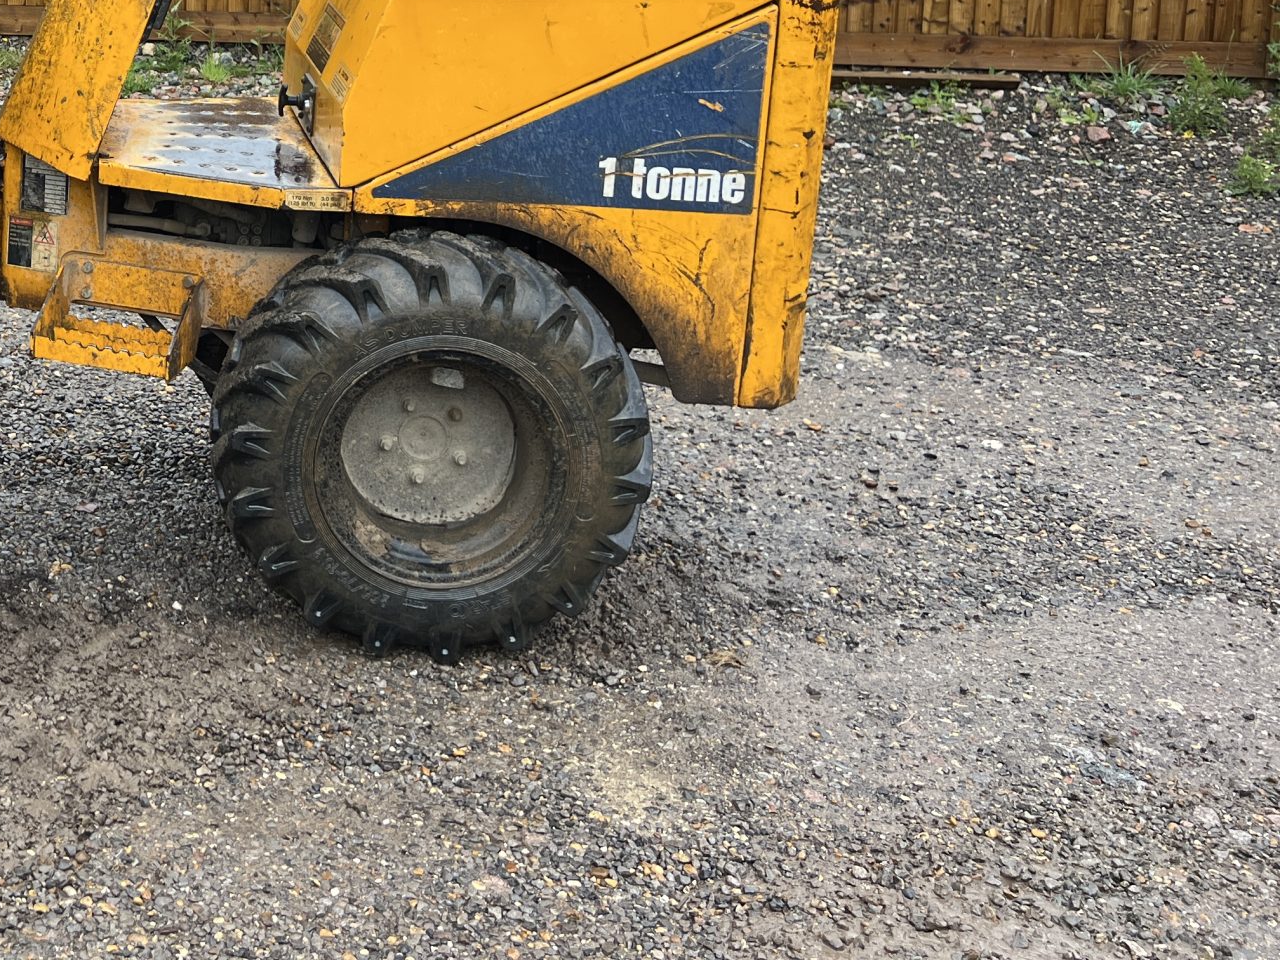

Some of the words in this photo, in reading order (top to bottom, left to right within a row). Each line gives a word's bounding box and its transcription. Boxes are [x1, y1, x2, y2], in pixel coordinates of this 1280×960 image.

[598, 157, 617, 198] 1
[631, 157, 746, 204] tonne
[383, 316, 469, 340] DUMPER
